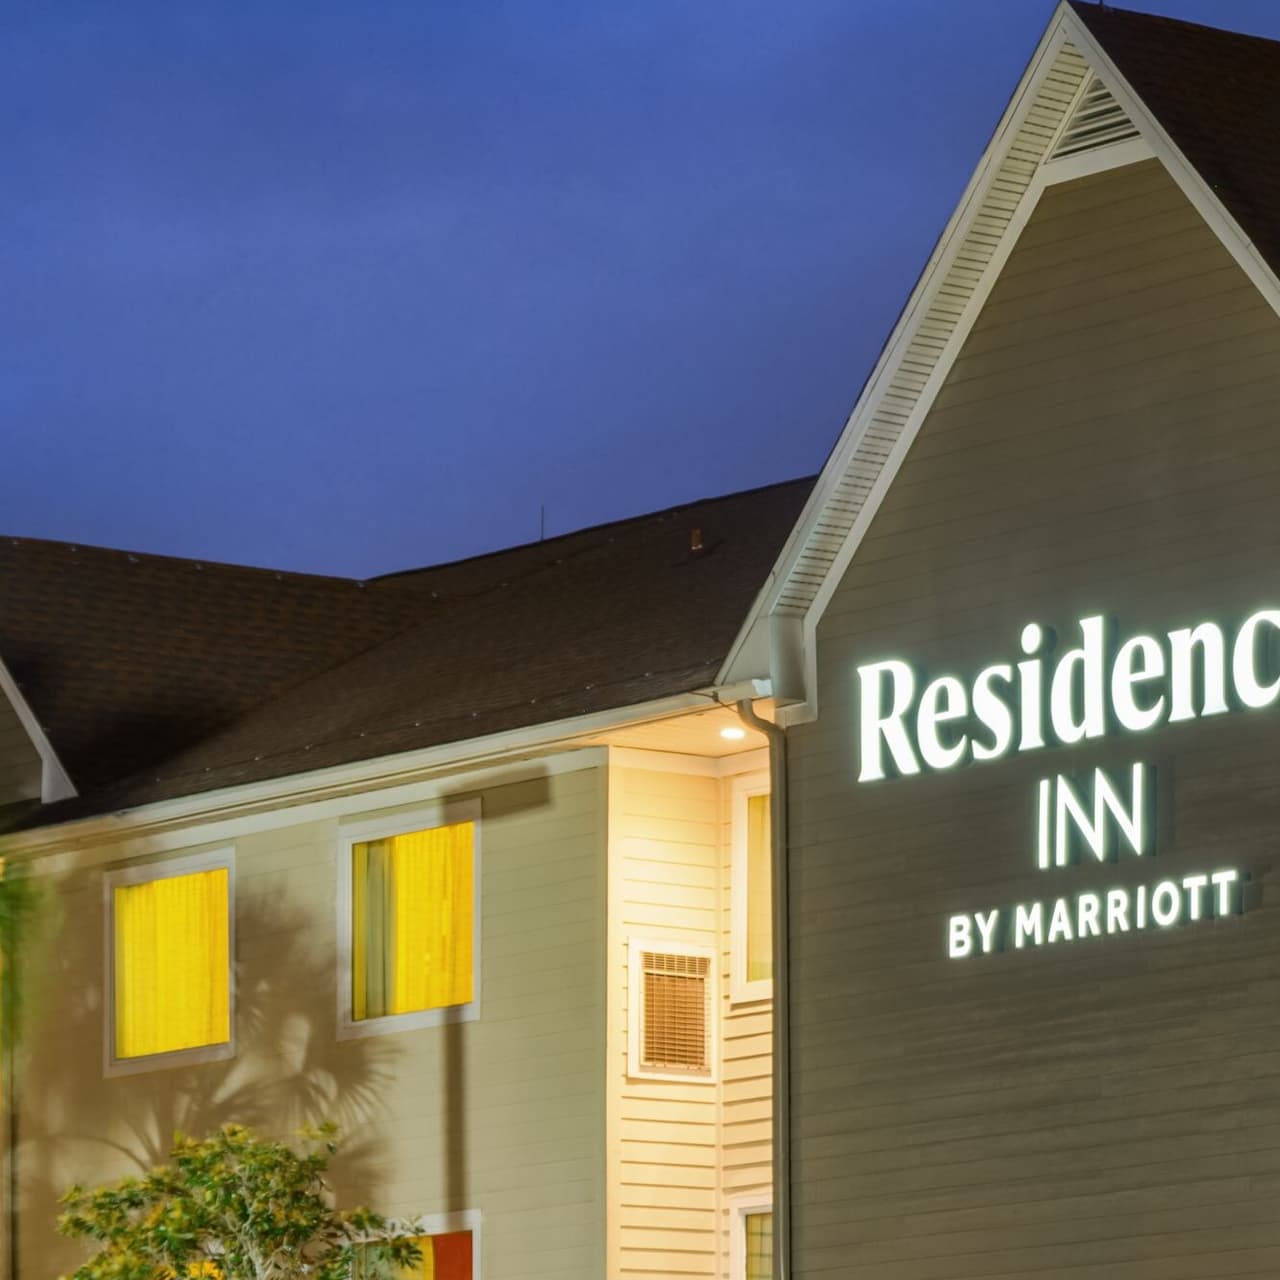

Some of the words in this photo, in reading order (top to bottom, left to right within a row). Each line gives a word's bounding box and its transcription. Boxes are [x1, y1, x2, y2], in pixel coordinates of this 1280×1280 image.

[1037, 762, 1143, 870] INN
[948, 909, 999, 959] BY
[1014, 869, 1238, 949] MARRIOTT
